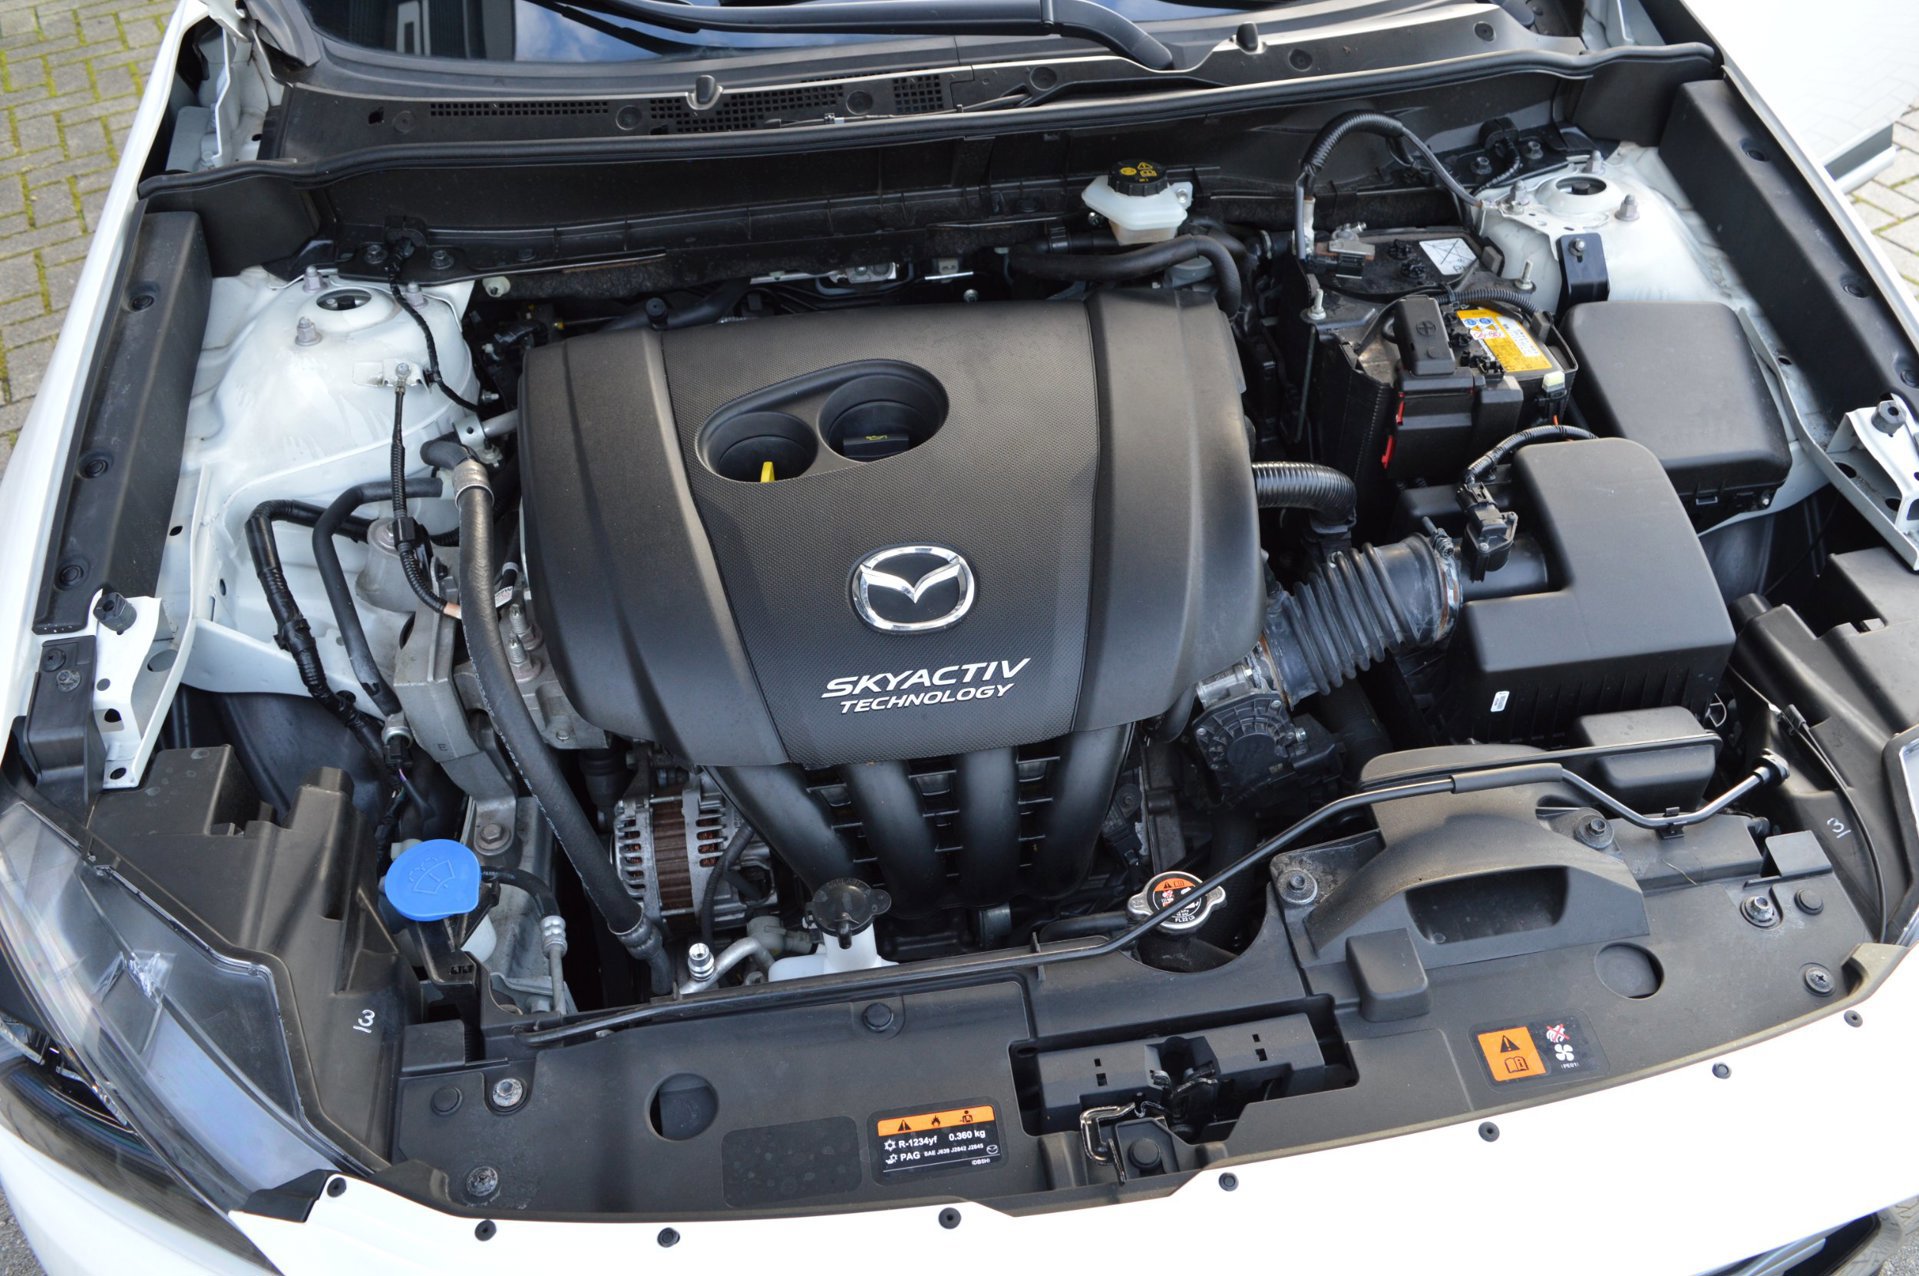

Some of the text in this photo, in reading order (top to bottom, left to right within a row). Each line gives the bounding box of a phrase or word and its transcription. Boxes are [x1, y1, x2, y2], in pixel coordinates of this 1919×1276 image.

[821, 657, 1032, 698] SKYACTIV
[839, 683, 1016, 714] TECHNOLOGY
[357, 1009, 376, 1028] 3
[898, 1129, 986, 1149] R-1234yf 0.360 kg
[900, 1151, 921, 1162] PAG
